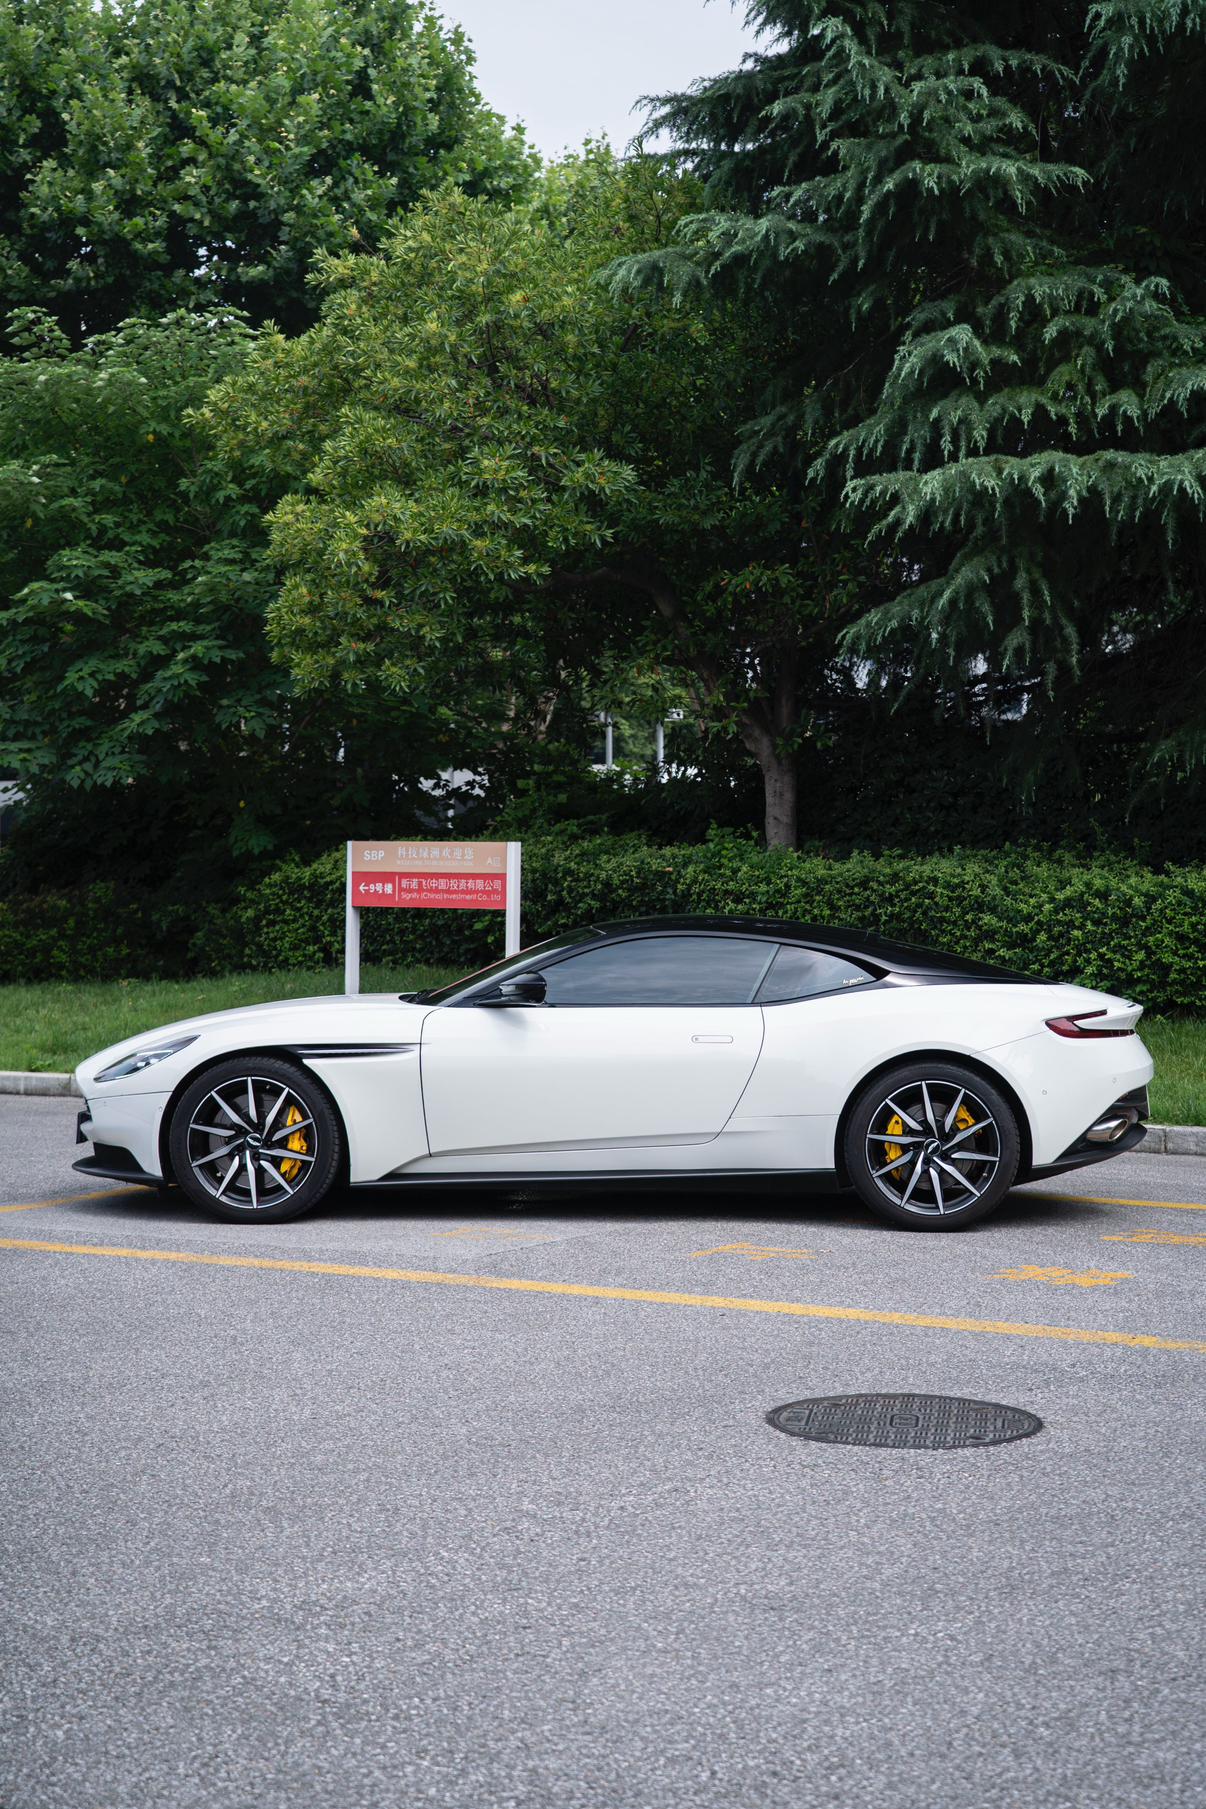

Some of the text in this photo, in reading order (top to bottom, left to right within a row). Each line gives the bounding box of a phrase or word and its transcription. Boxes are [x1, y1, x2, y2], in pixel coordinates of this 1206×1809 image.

[363, 850, 385, 861] SBP
[397, 846, 475, 860] 科技绿洲欢迎您
[369, 882, 393, 895] 9号楼
[401, 891, 420, 900] Signify
[420, 891, 443, 900] (China)
[443, 892, 477, 900] Investment
